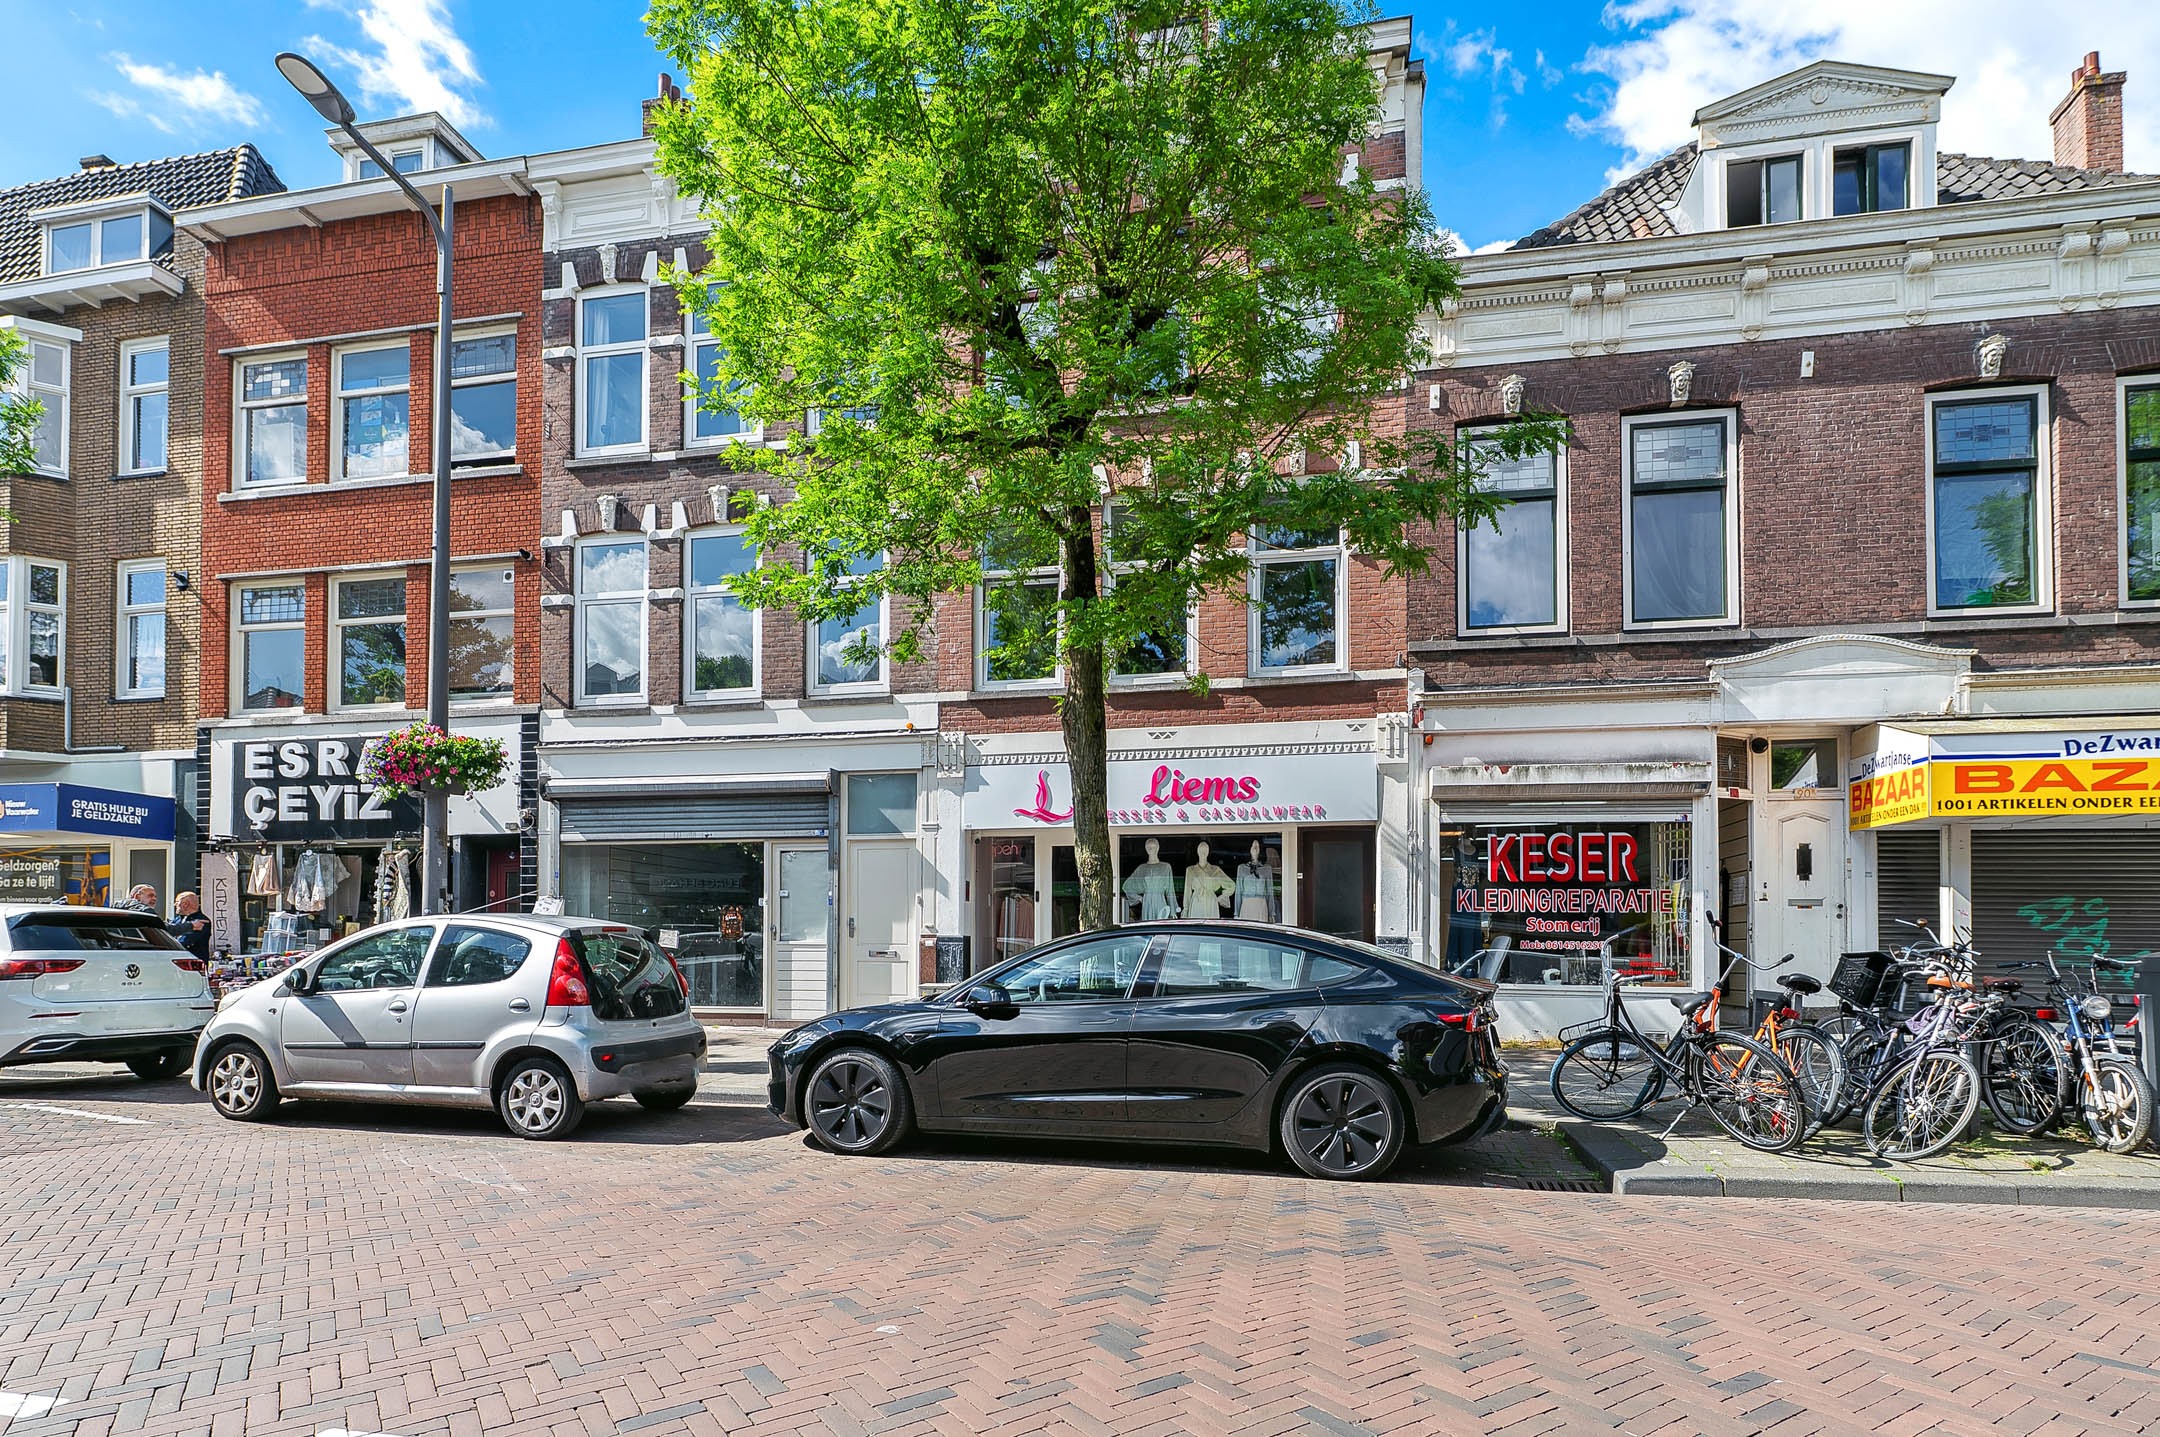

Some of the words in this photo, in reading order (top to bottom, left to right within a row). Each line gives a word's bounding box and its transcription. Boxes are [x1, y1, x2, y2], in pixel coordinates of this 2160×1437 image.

[1143, 765, 1260, 806] Liems
[1955, 762, 2160, 794] BAZ
[1852, 768, 1924, 812] BAZAAR
[72, 800, 107, 812] GRATIS
[109, 803, 134, 814] HULP
[136, 807, 148, 816] BIJ
[1107, 808, 1167, 823] ESSES
[1176, 808, 1190, 823] &
[1199, 804, 1327, 822] CASUALWEAR
[1882, 807, 1899, 820] ONDER
[1899, 804, 1909, 816] EEN
[1909, 804, 1921, 815] DAK
[1937, 799, 1973, 813] 1001
[1977, 798, 2067, 810] ARTIKELEN
[2073, 797, 2133, 809] ONDER
[2140, 796, 2160, 808] EE
[71, 808, 82, 818] JE
[84, 811, 142, 824] GELDZAKEN
[992, 844, 1019, 857] pen
[1487, 832, 1639, 882] KESER
[12, 878, 25, 888] ze
[26, 876, 37, 888] te
[39, 875, 55, 890] lijf!
[215, 877, 229, 942] KITCHEN
[1456, 888, 1674, 914] KLEDINGREPARATIE
[1526, 917, 1601, 937] Stomerij
[1520, 940, 1546, 950] Mob:
